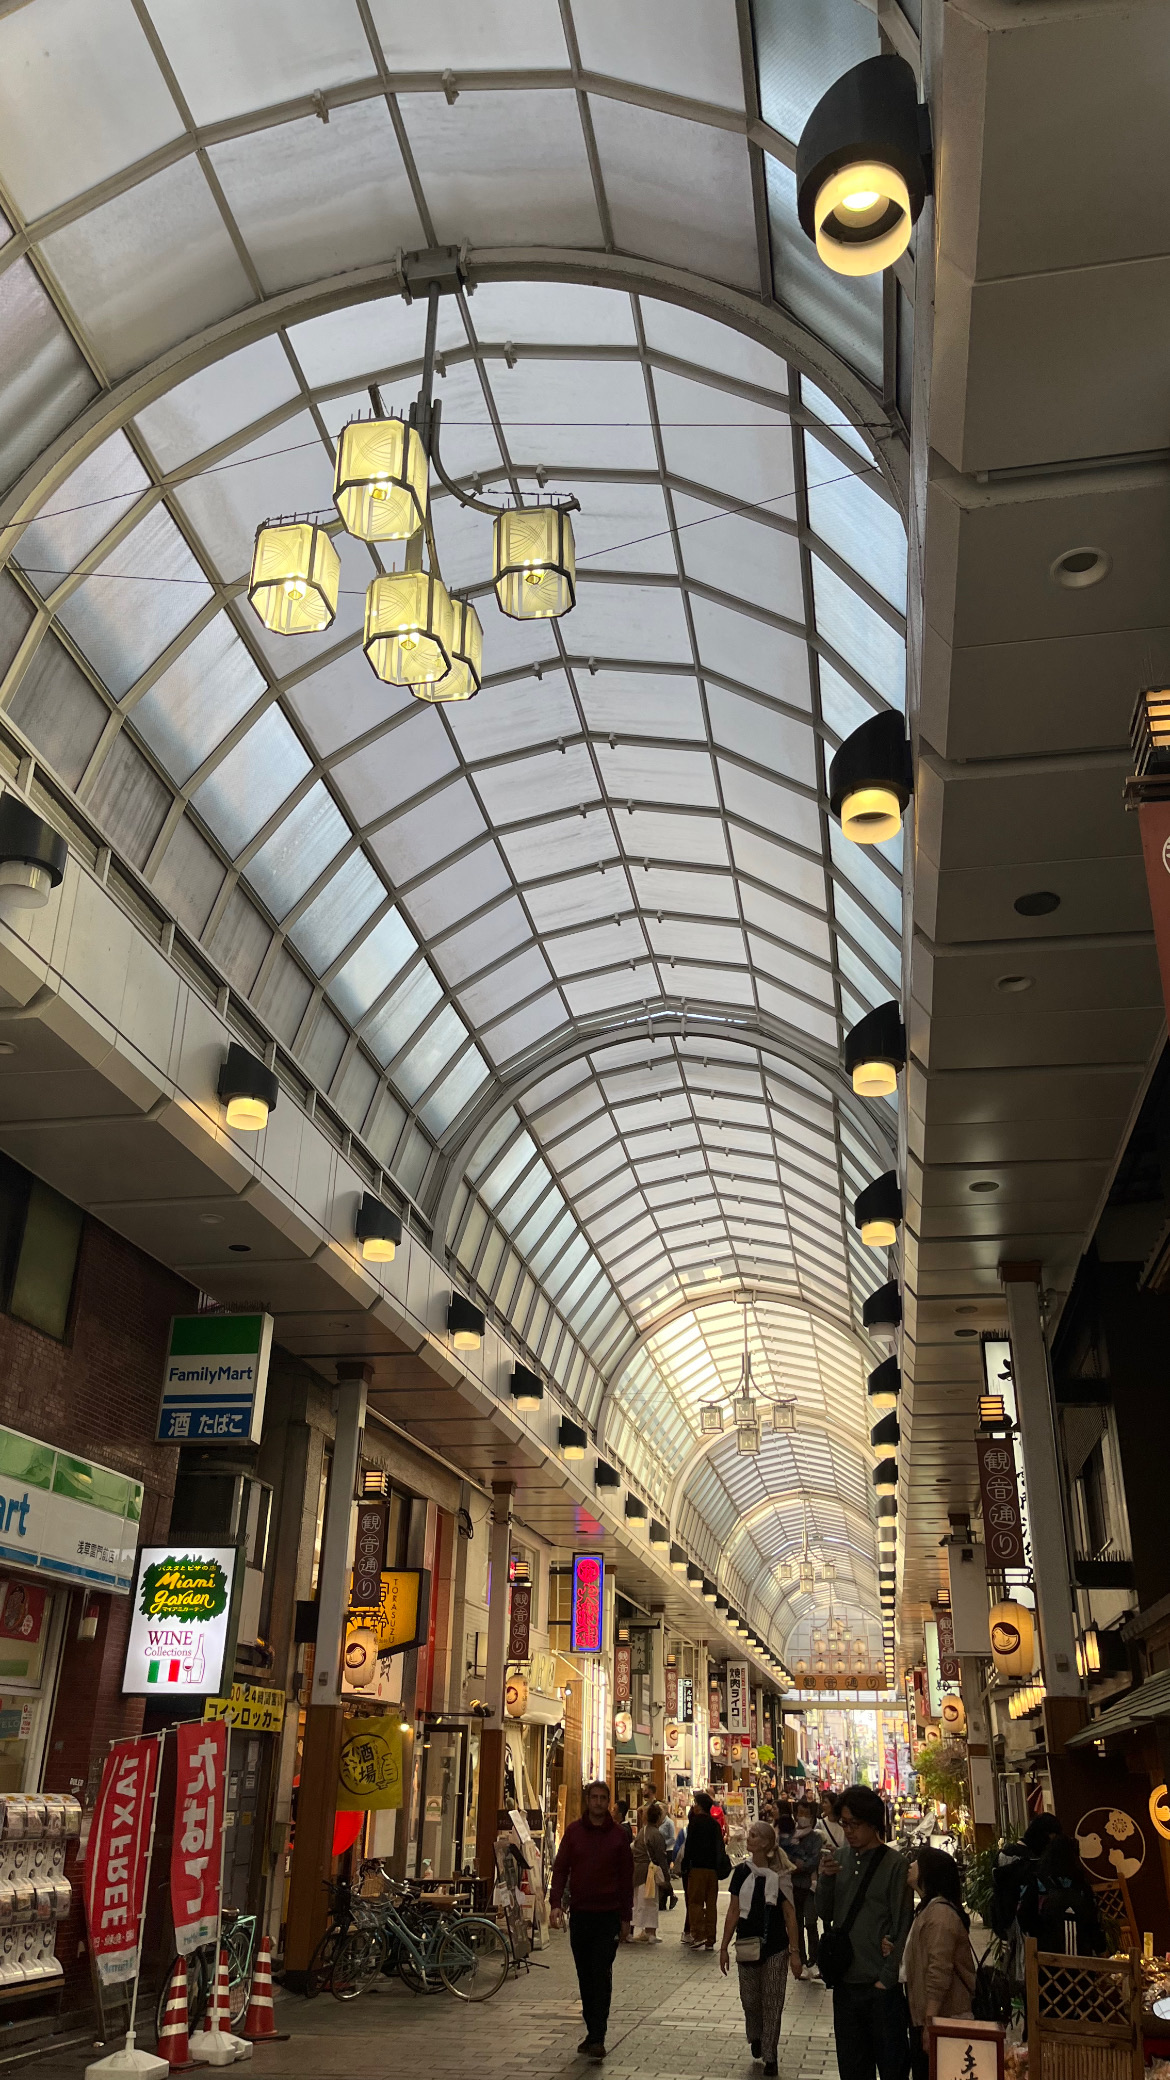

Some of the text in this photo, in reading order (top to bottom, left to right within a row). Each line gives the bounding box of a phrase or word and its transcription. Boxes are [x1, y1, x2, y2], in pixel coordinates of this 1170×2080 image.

[169, 1366, 253, 1384] FamilyMart
[168, 1412, 243, 1437] 酒 たばこ
[984, 1448, 1019, 1559] 観音通り
[77, 1540, 115, 1564] 浅草雷門前店
[356, 1512, 381, 1599] 観音通り
[155, 1572, 216, 1590] Miami
[389, 1578, 399, 1644] TORASUZU
[511, 1591, 529, 1655] 観音通り
[147, 1631, 193, 1646] WINE
[144, 1647, 192, 1657] Collections
[617, 1650, 629, 1698] 観音通り
[803, 1675, 880, 1690] 観音通り
[206, 1703, 281, 1729] コインロッカー
